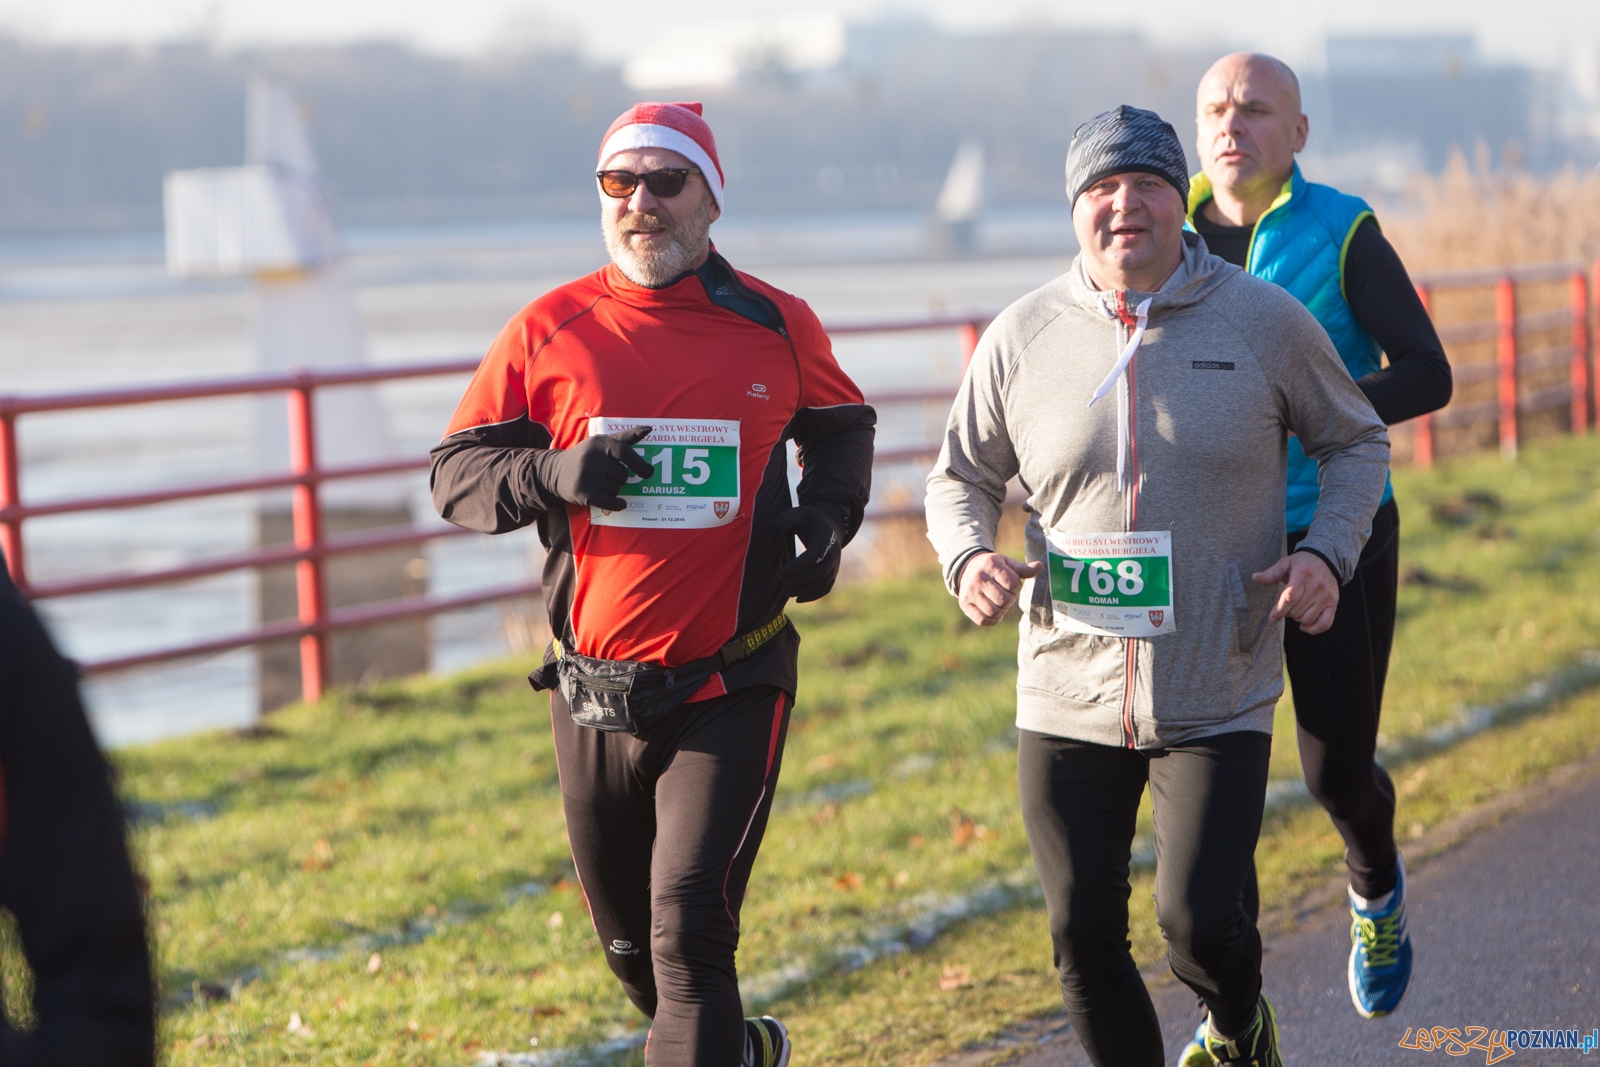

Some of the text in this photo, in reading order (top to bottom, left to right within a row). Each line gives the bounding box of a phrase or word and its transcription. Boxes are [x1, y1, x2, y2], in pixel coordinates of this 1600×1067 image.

[659, 424, 729, 433] SYLWESTROWY
[641, 435, 725, 443] SZARDA BURGIELA
[642, 486, 686, 495] DARIUSZ
[1072, 538, 1092, 546] BIEG
[1093, 537, 1160, 546] SYLWESTROWY
[1068, 547, 1110, 556] RYSZARDA
[1112, 546, 1156, 555] BURGIELA
[1062, 559, 1145, 596] 768
[1089, 596, 1119, 605] ROMAN
[583, 702, 616, 717] SPORTS
